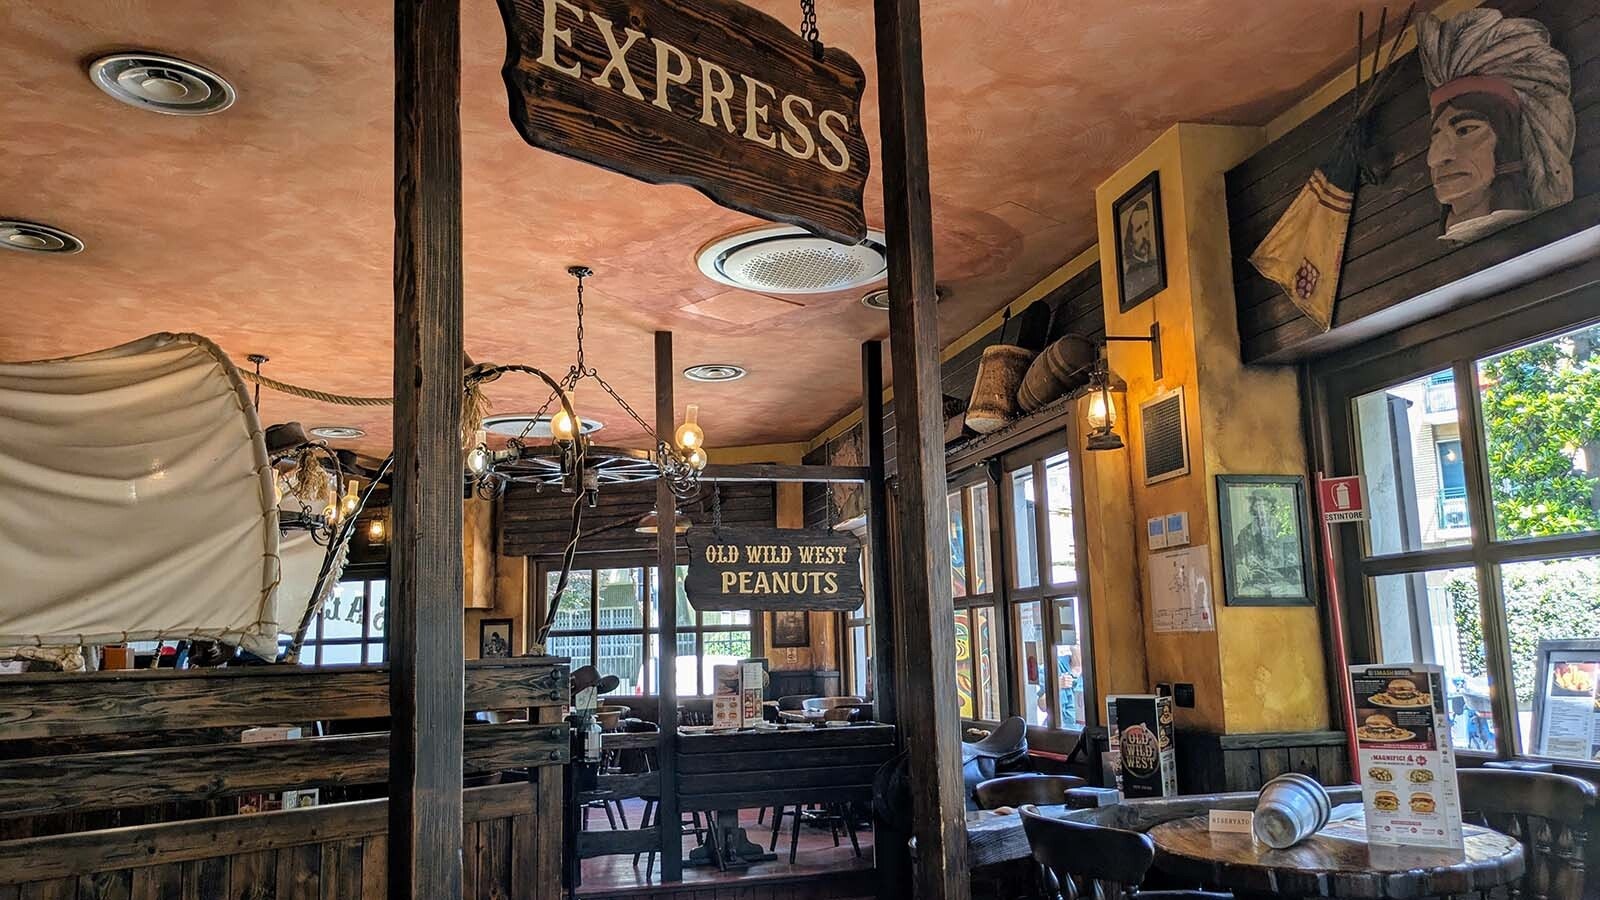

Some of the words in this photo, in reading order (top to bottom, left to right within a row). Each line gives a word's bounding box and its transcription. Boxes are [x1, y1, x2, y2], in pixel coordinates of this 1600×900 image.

[536, 0, 851, 173] EXPRESS
[1325, 511, 1363, 521] ESTINTORE
[705, 544, 740, 564] OLD
[745, 544, 792, 564] WILD
[797, 545, 847, 565] WEST
[720, 571, 839, 595] PEANUTS
[1128, 733, 1149, 745] OLD
[1126, 744, 1153, 757] WILD
[1126, 755, 1155, 769] WEST
